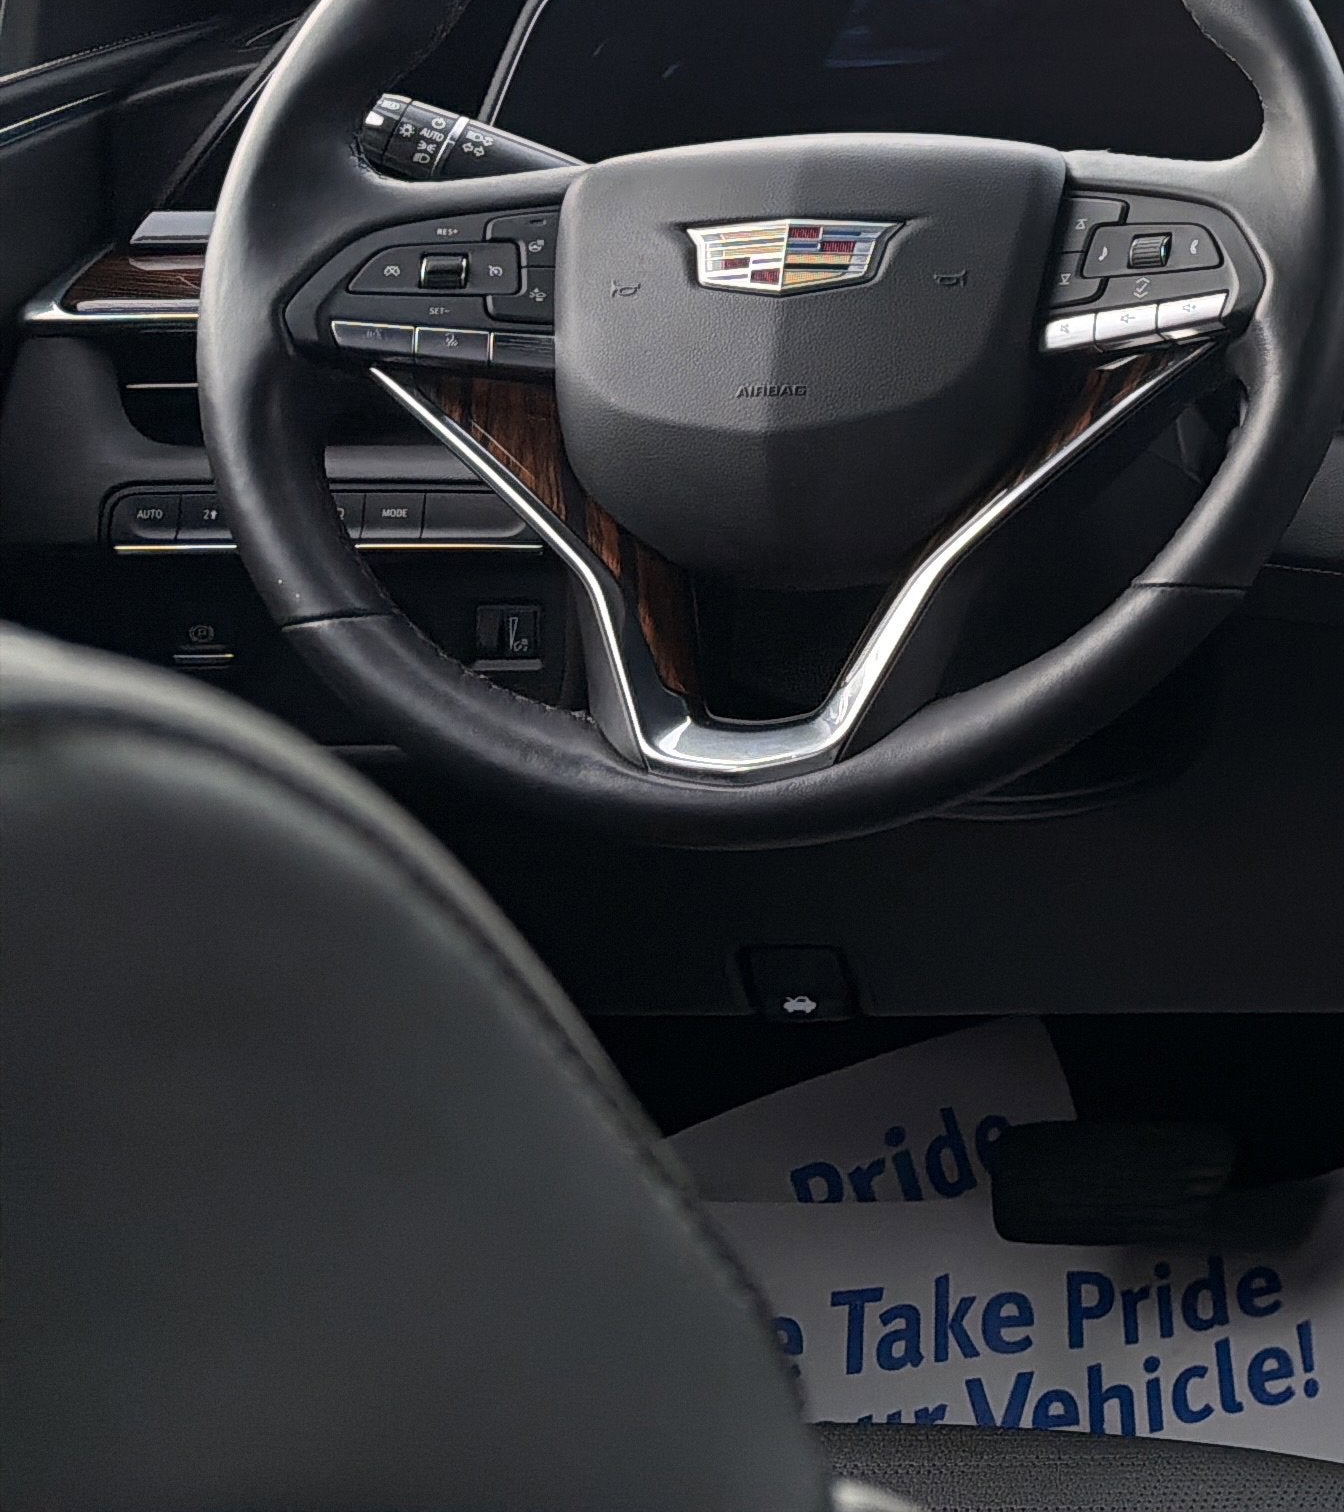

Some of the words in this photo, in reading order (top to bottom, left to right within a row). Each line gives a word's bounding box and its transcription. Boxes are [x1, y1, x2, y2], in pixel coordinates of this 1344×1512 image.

[419, 127, 445, 143] AUTO
[435, 227, 459, 237] RES+
[735, 384, 808, 400] AIRBAG
[136, 508, 164, 521] AUTO
[381, 507, 409, 520] MODE
[830, 1273, 1034, 1376] Take
[1065, 1255, 1283, 1350] Pride
[963, 1320, 1321, 1436] Vehicle!
